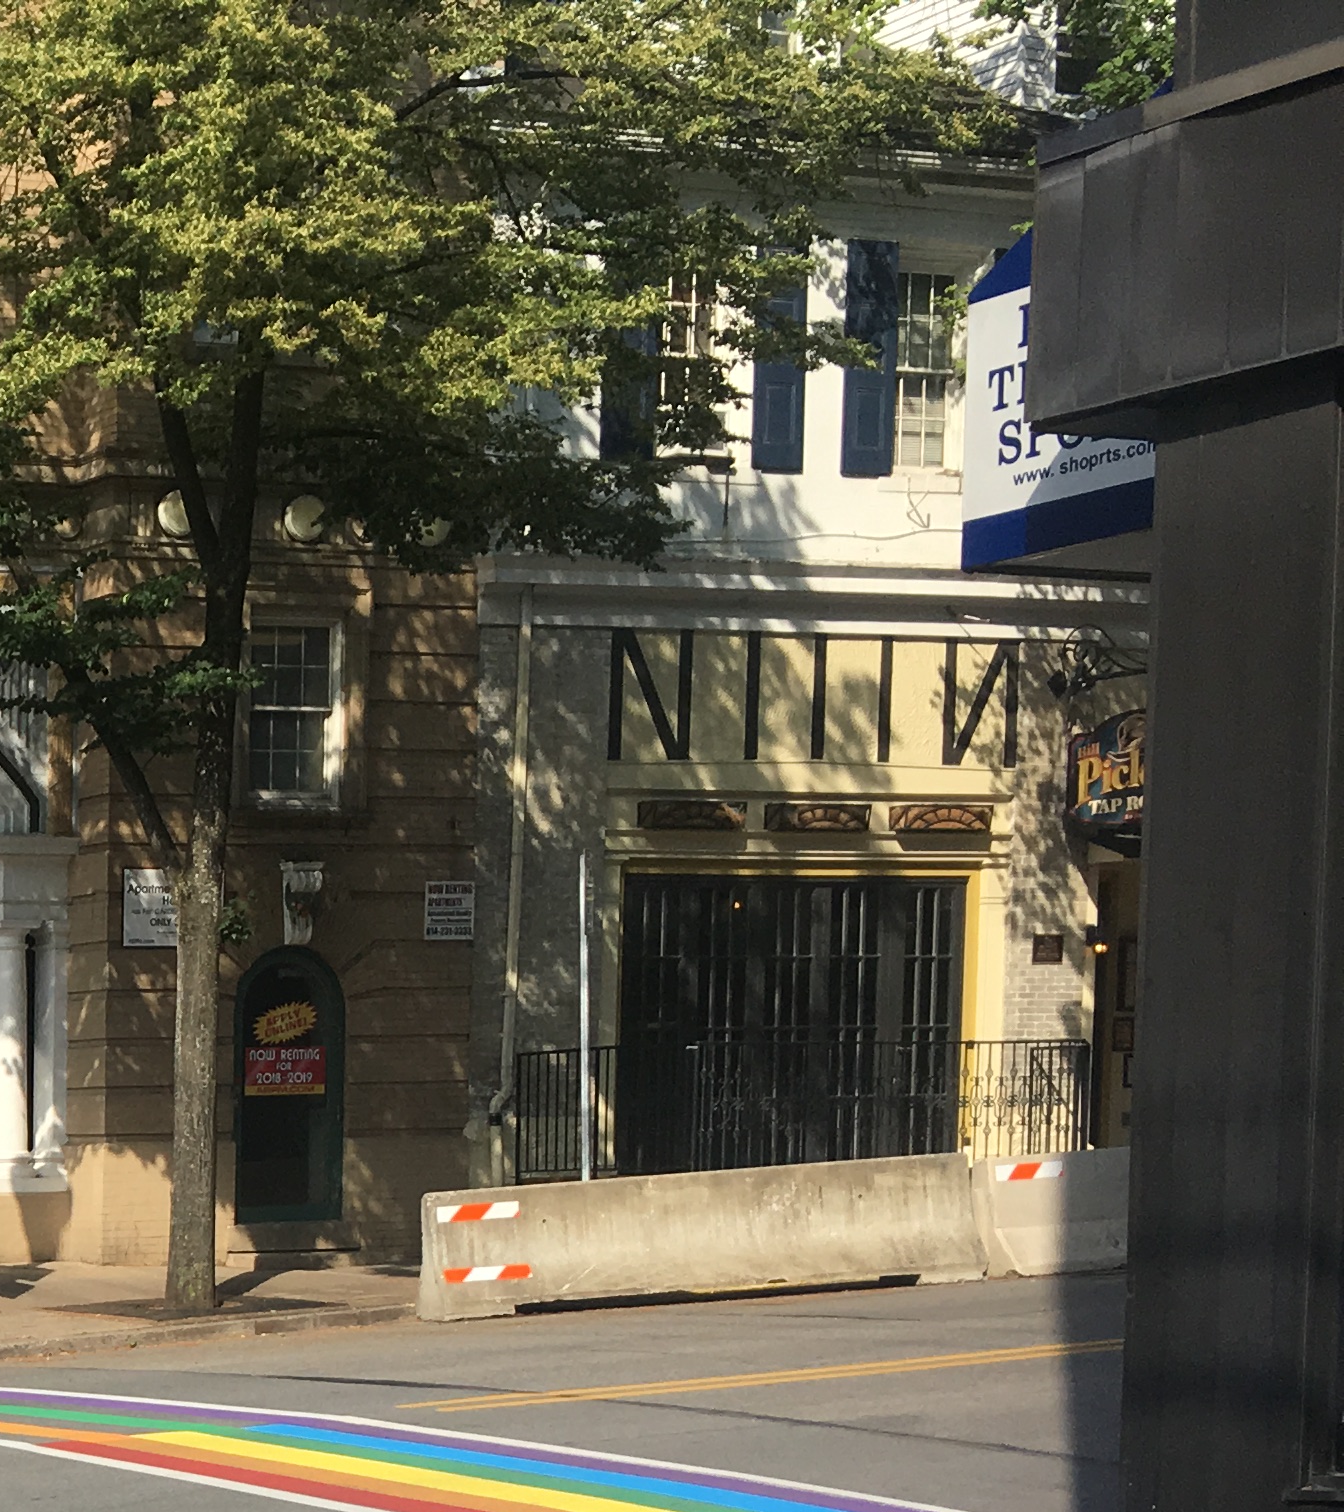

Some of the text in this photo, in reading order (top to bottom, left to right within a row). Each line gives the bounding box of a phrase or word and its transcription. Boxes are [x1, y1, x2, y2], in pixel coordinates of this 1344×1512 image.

[1075, 748, 1145, 809] Pick
[1088, 798, 1123, 815] TAP
[149, 918, 172, 927] ONLY
[266, 1008, 301, 1027] APPLY
[280, 1048, 320, 1061] RENTING
[276, 1061, 292, 1071] FOR
[256, 1071, 313, 1084] 2018-2019
